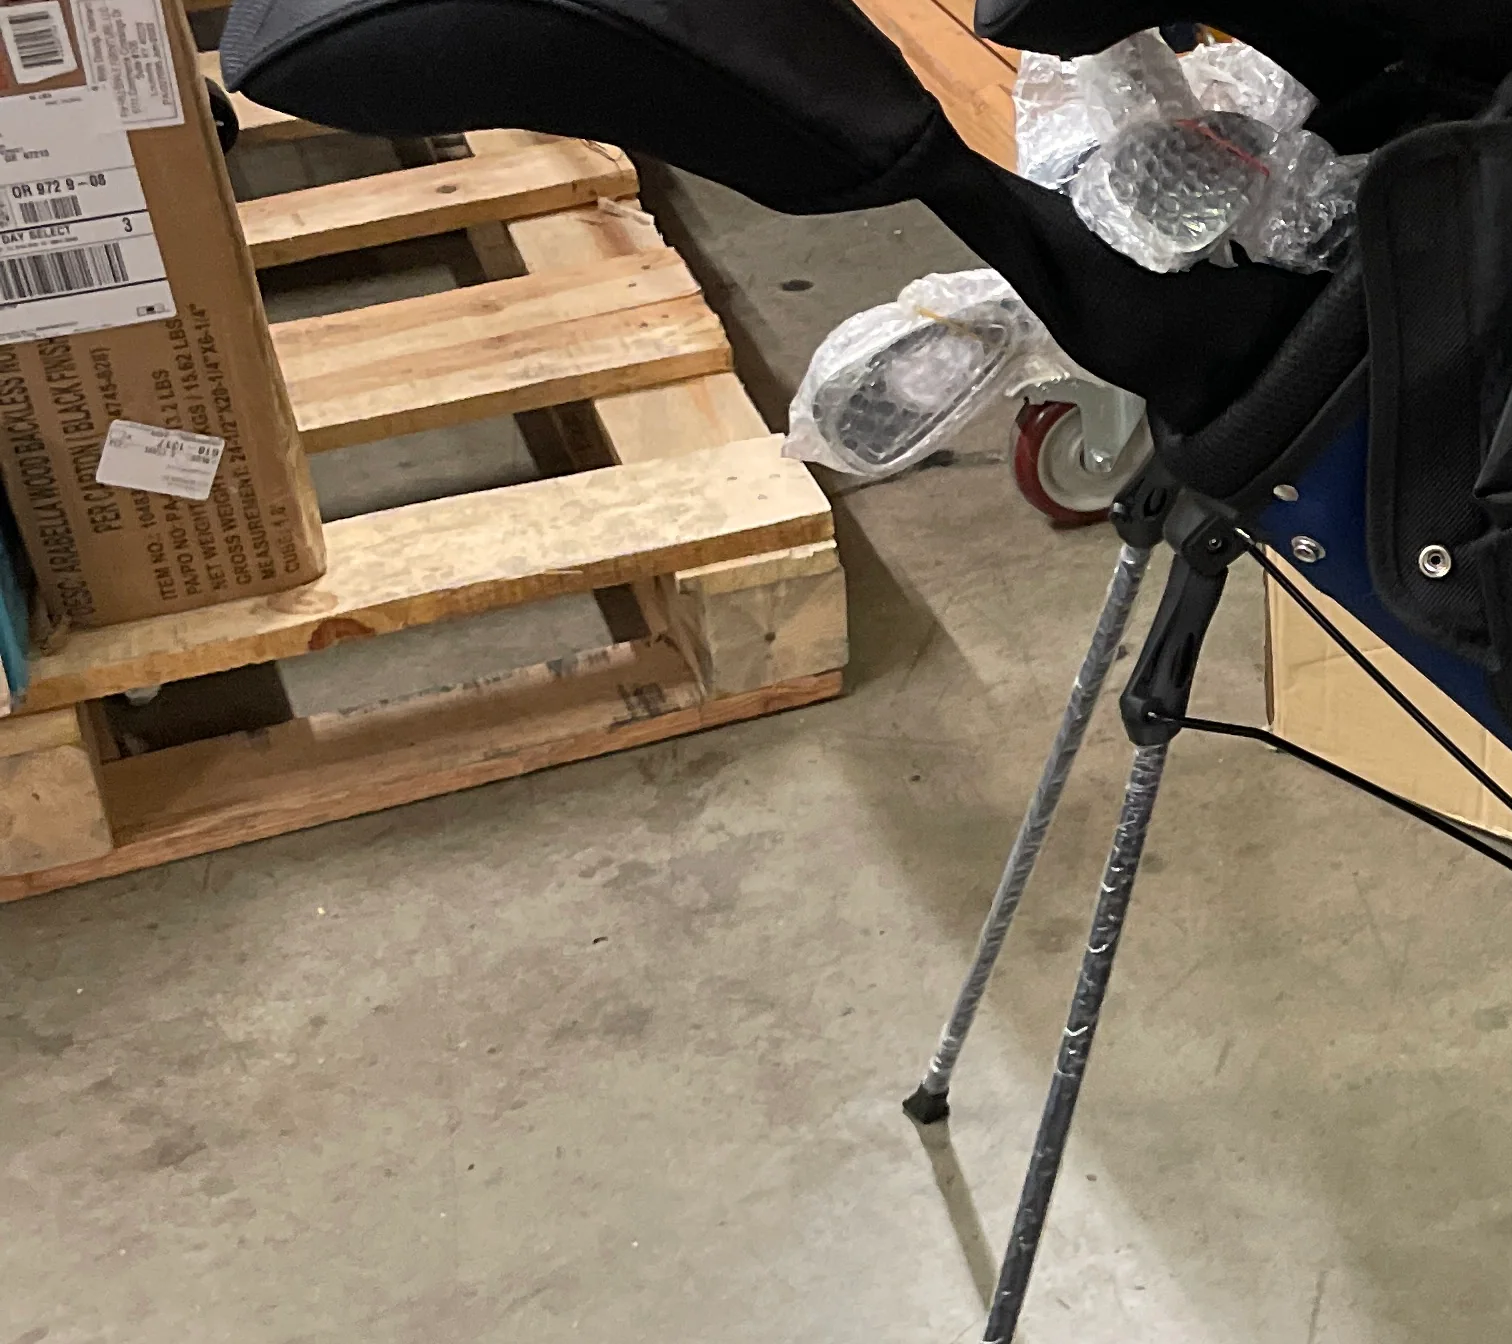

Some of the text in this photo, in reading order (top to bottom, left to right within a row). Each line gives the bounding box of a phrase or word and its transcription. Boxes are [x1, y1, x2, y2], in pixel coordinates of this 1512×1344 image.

[1, 232, 24, 244] DAY
[121, 216, 132, 232] 3
[164, 317, 188, 349] LBS
[150, 367, 174, 400] LBS
[49, 381, 94, 435] BLACK
[86, 502, 123, 534] PER
[223, 534, 252, 585] GROSS
[153, 566, 178, 600] ITEM
